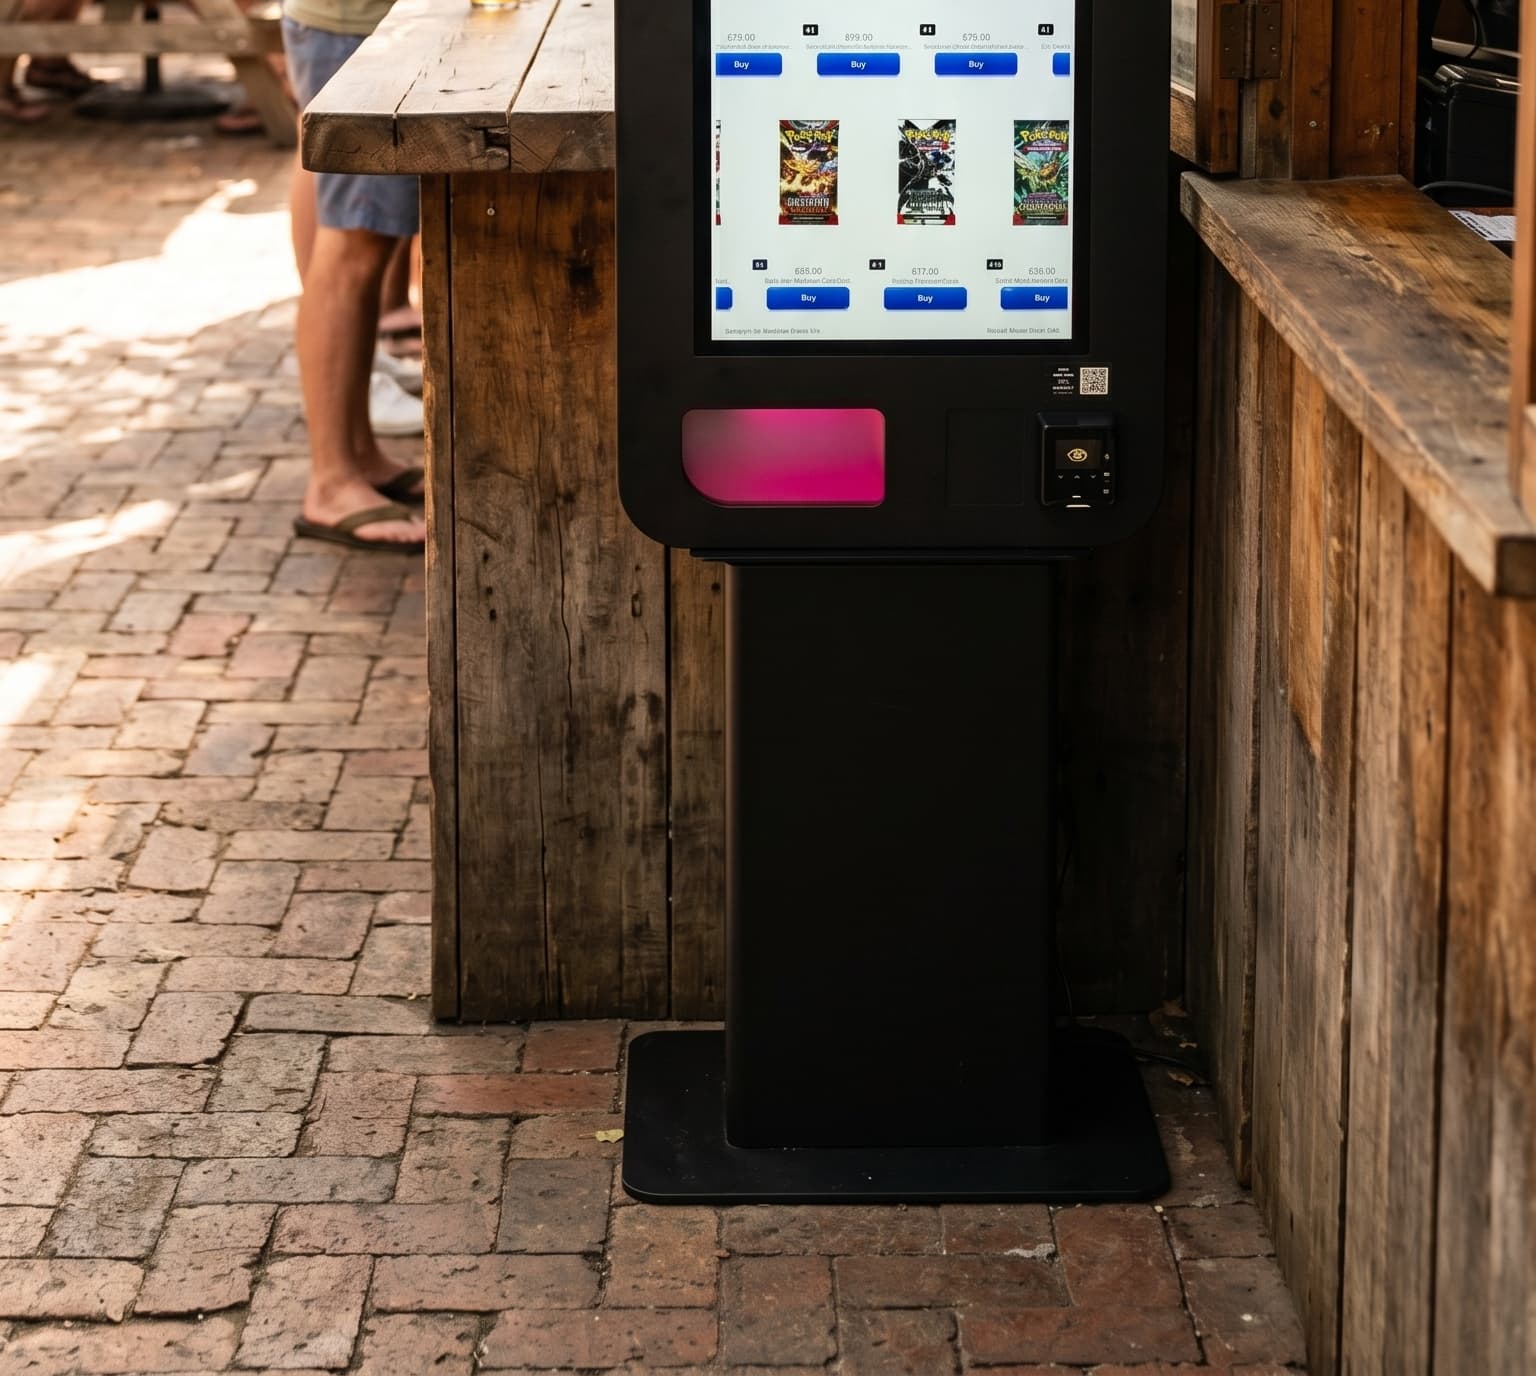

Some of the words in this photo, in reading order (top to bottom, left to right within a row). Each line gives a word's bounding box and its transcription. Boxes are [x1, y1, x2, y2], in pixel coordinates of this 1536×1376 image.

[734, 60, 750, 70] Buy
[850, 60, 867, 70] Buy
[968, 60, 985, 70] Buy
[801, 293, 817, 304] Buy
[917, 294, 934, 304] Buy
[1034, 294, 1050, 304] Buy
